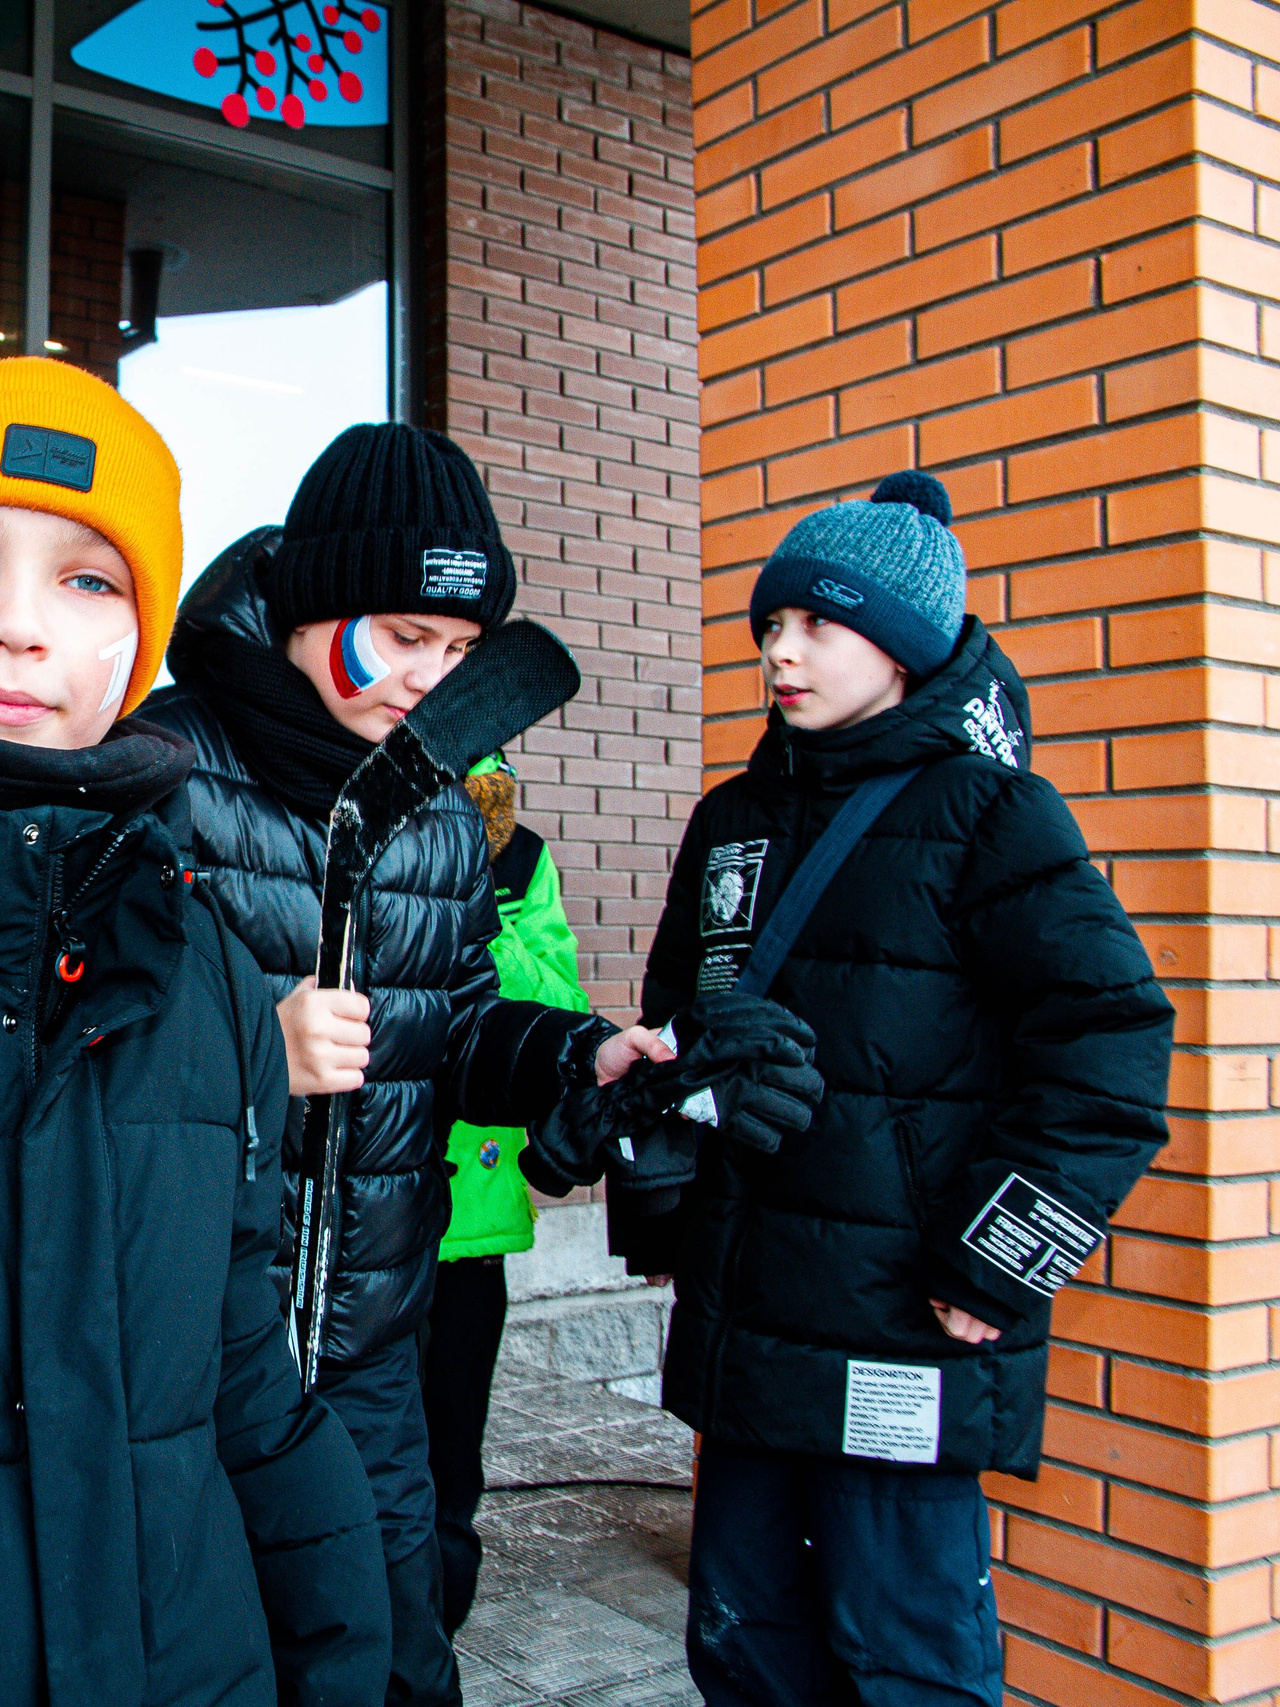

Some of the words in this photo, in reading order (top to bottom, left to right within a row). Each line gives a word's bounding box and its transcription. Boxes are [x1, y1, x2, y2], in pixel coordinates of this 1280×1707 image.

[426, 586, 458, 594] QUALITY
[300, 1225, 310, 1247] IN
[296, 1246, 308, 1309] RUSSIA
[851, 1366, 924, 1381] DESIGNATION
